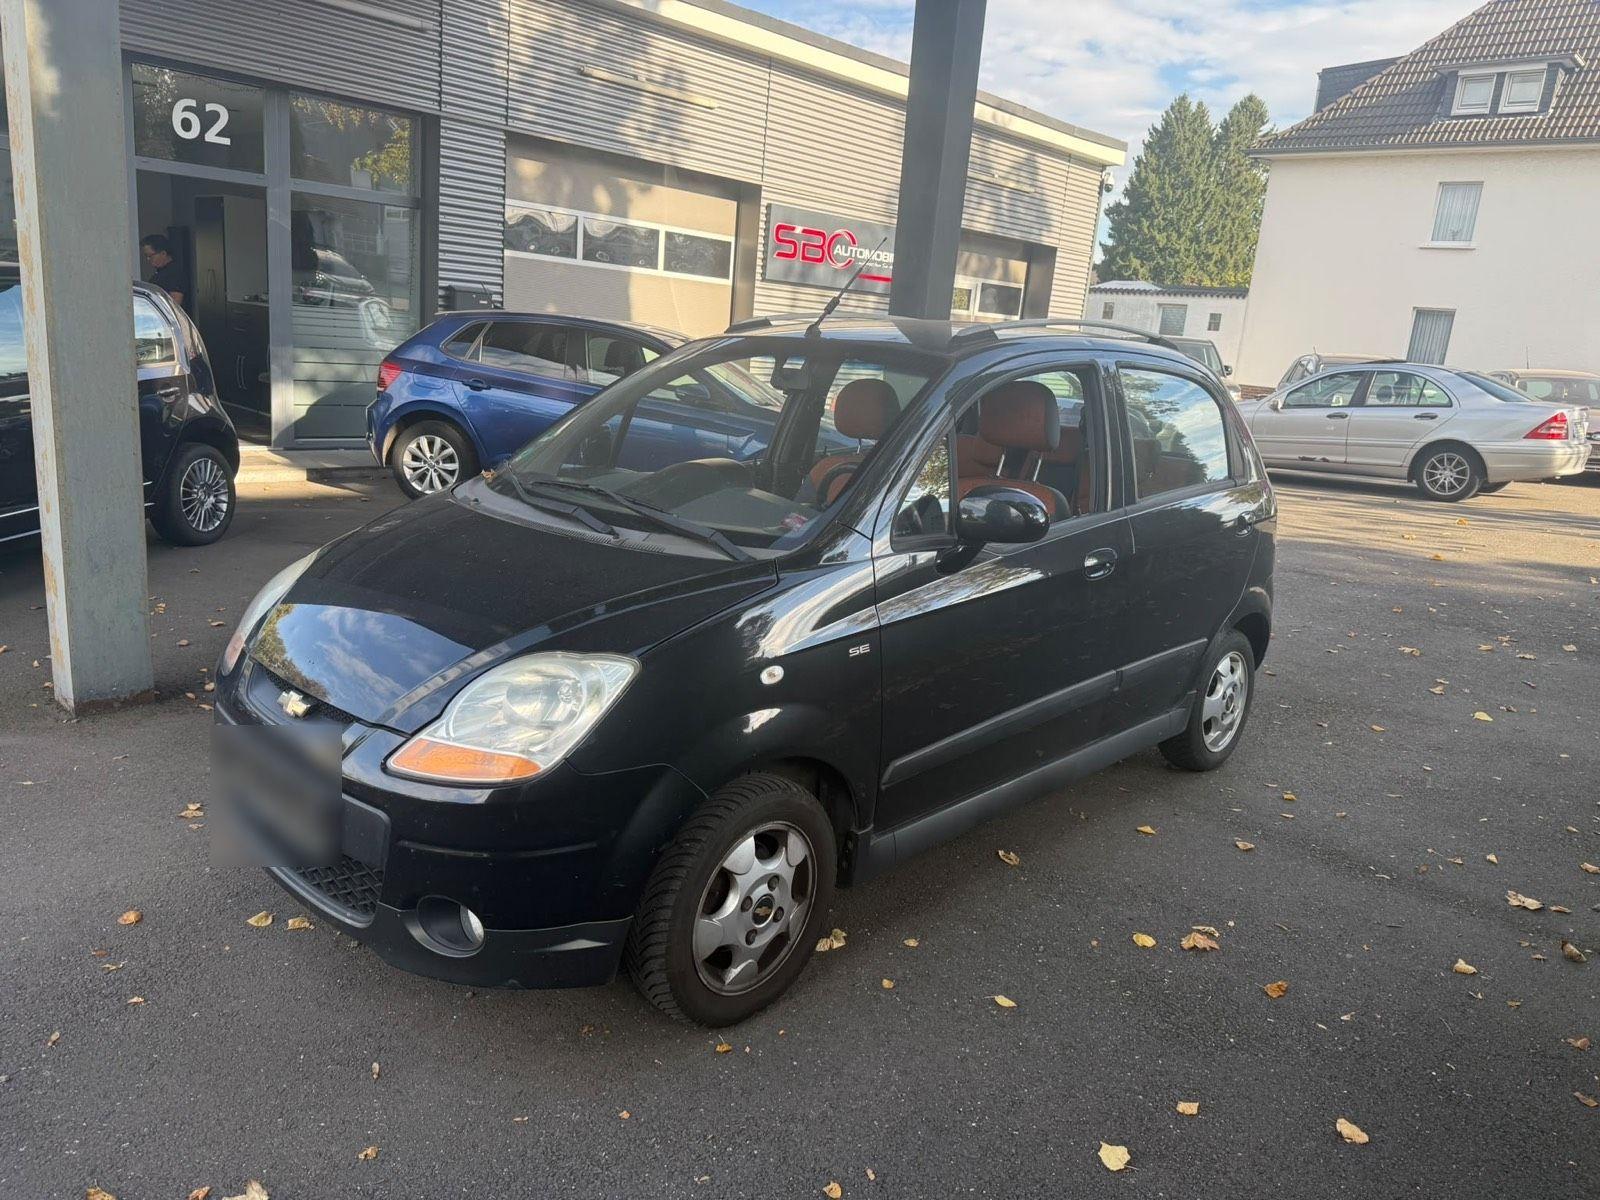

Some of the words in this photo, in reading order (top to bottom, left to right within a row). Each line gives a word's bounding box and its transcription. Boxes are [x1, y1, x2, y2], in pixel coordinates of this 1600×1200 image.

[172, 98, 231, 146] 62
[774, 223, 858, 270] SBC
[848, 643, 871, 657] SE
